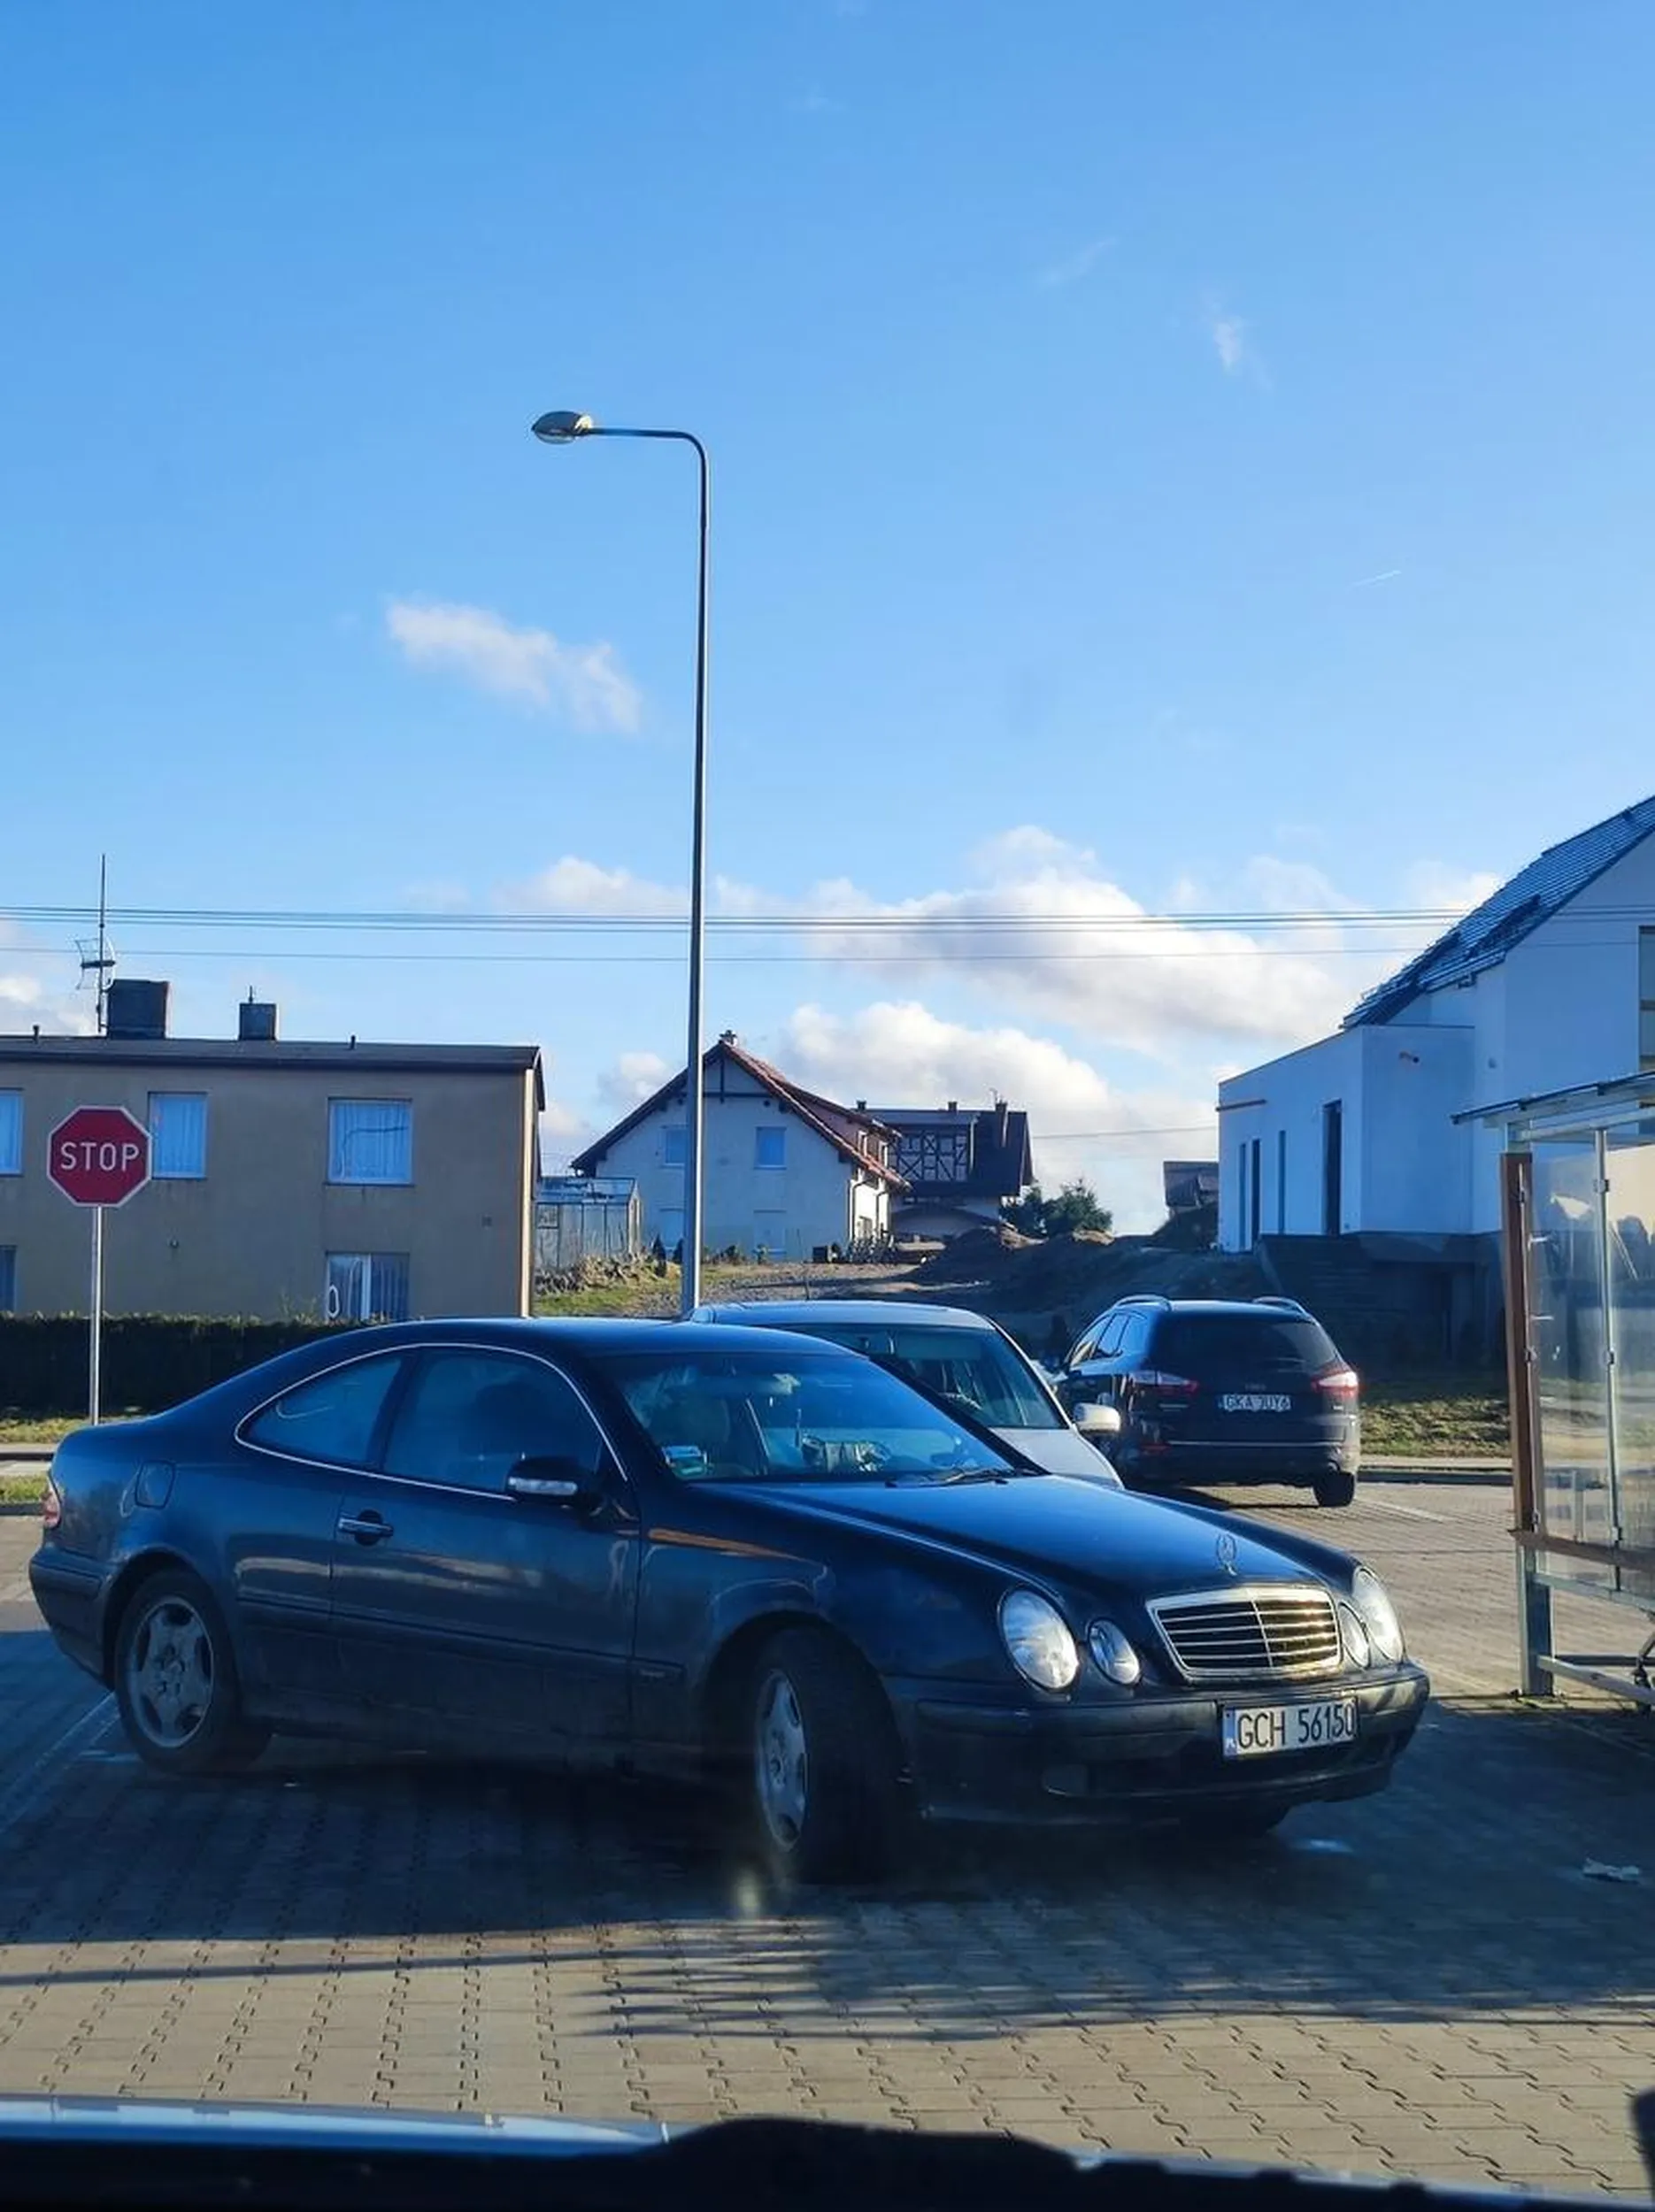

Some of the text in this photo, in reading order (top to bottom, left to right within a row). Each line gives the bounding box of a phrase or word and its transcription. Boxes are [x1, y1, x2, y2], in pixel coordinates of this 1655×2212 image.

[60, 1141, 140, 1172] STOP
[1237, 1703, 1355, 1749] GCH 56150
